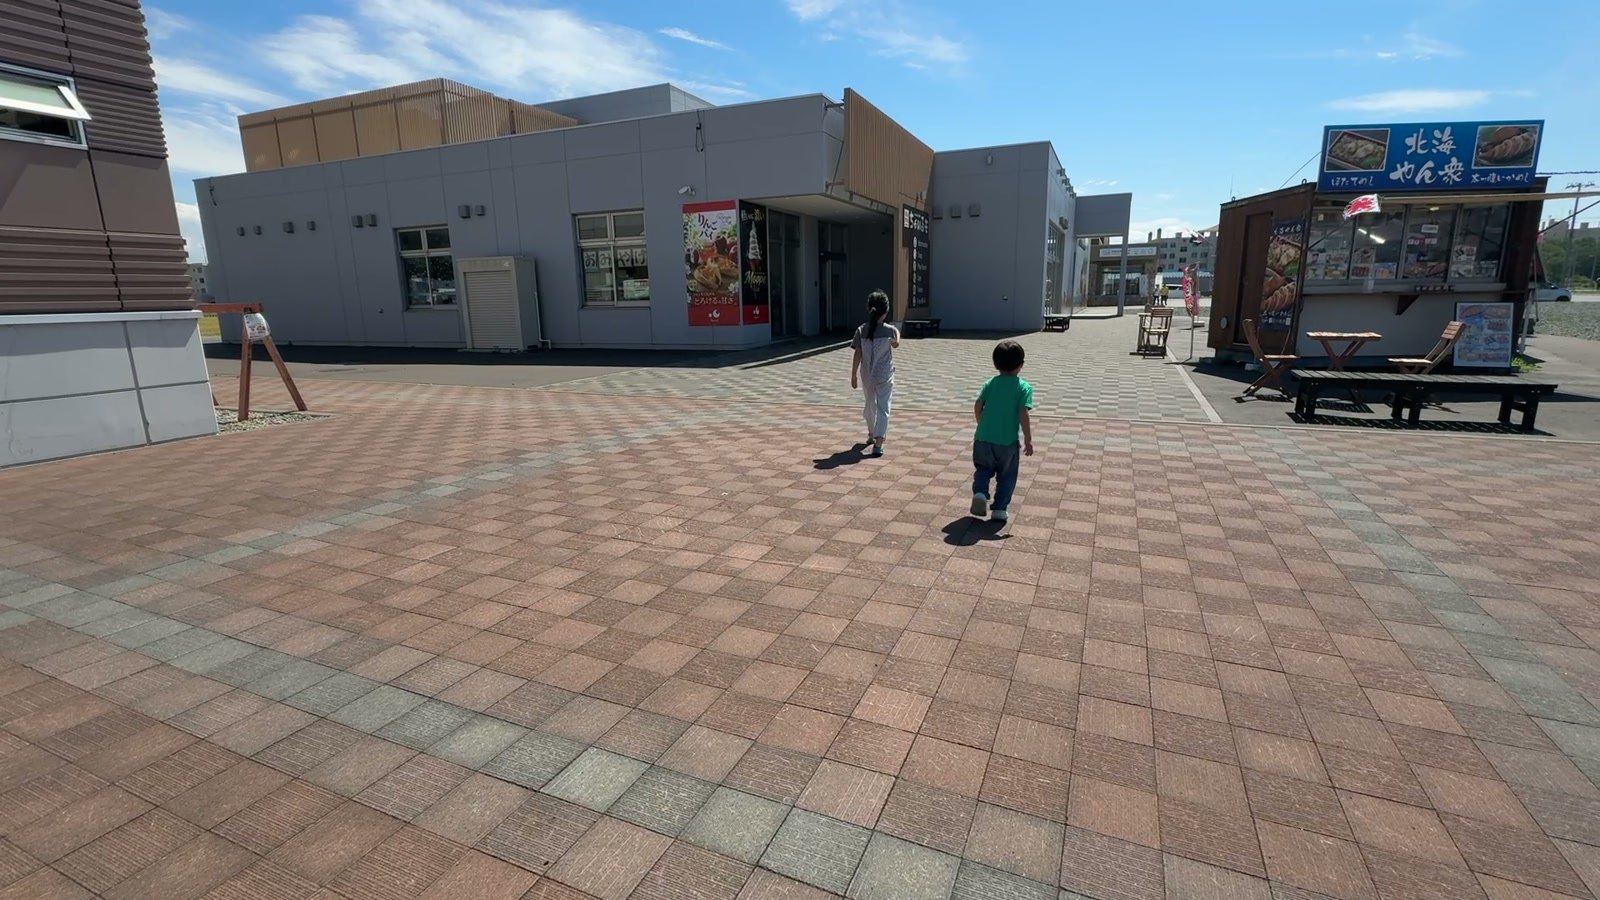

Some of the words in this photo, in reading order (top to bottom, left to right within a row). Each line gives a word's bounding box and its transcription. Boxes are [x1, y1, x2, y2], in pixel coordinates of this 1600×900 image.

[1405, 127, 1456, 155] 北海
[1331, 176, 1374, 186] ほたてめし
[1389, 157, 1465, 185] やん衆
[584, 247, 646, 268] おみやげ
